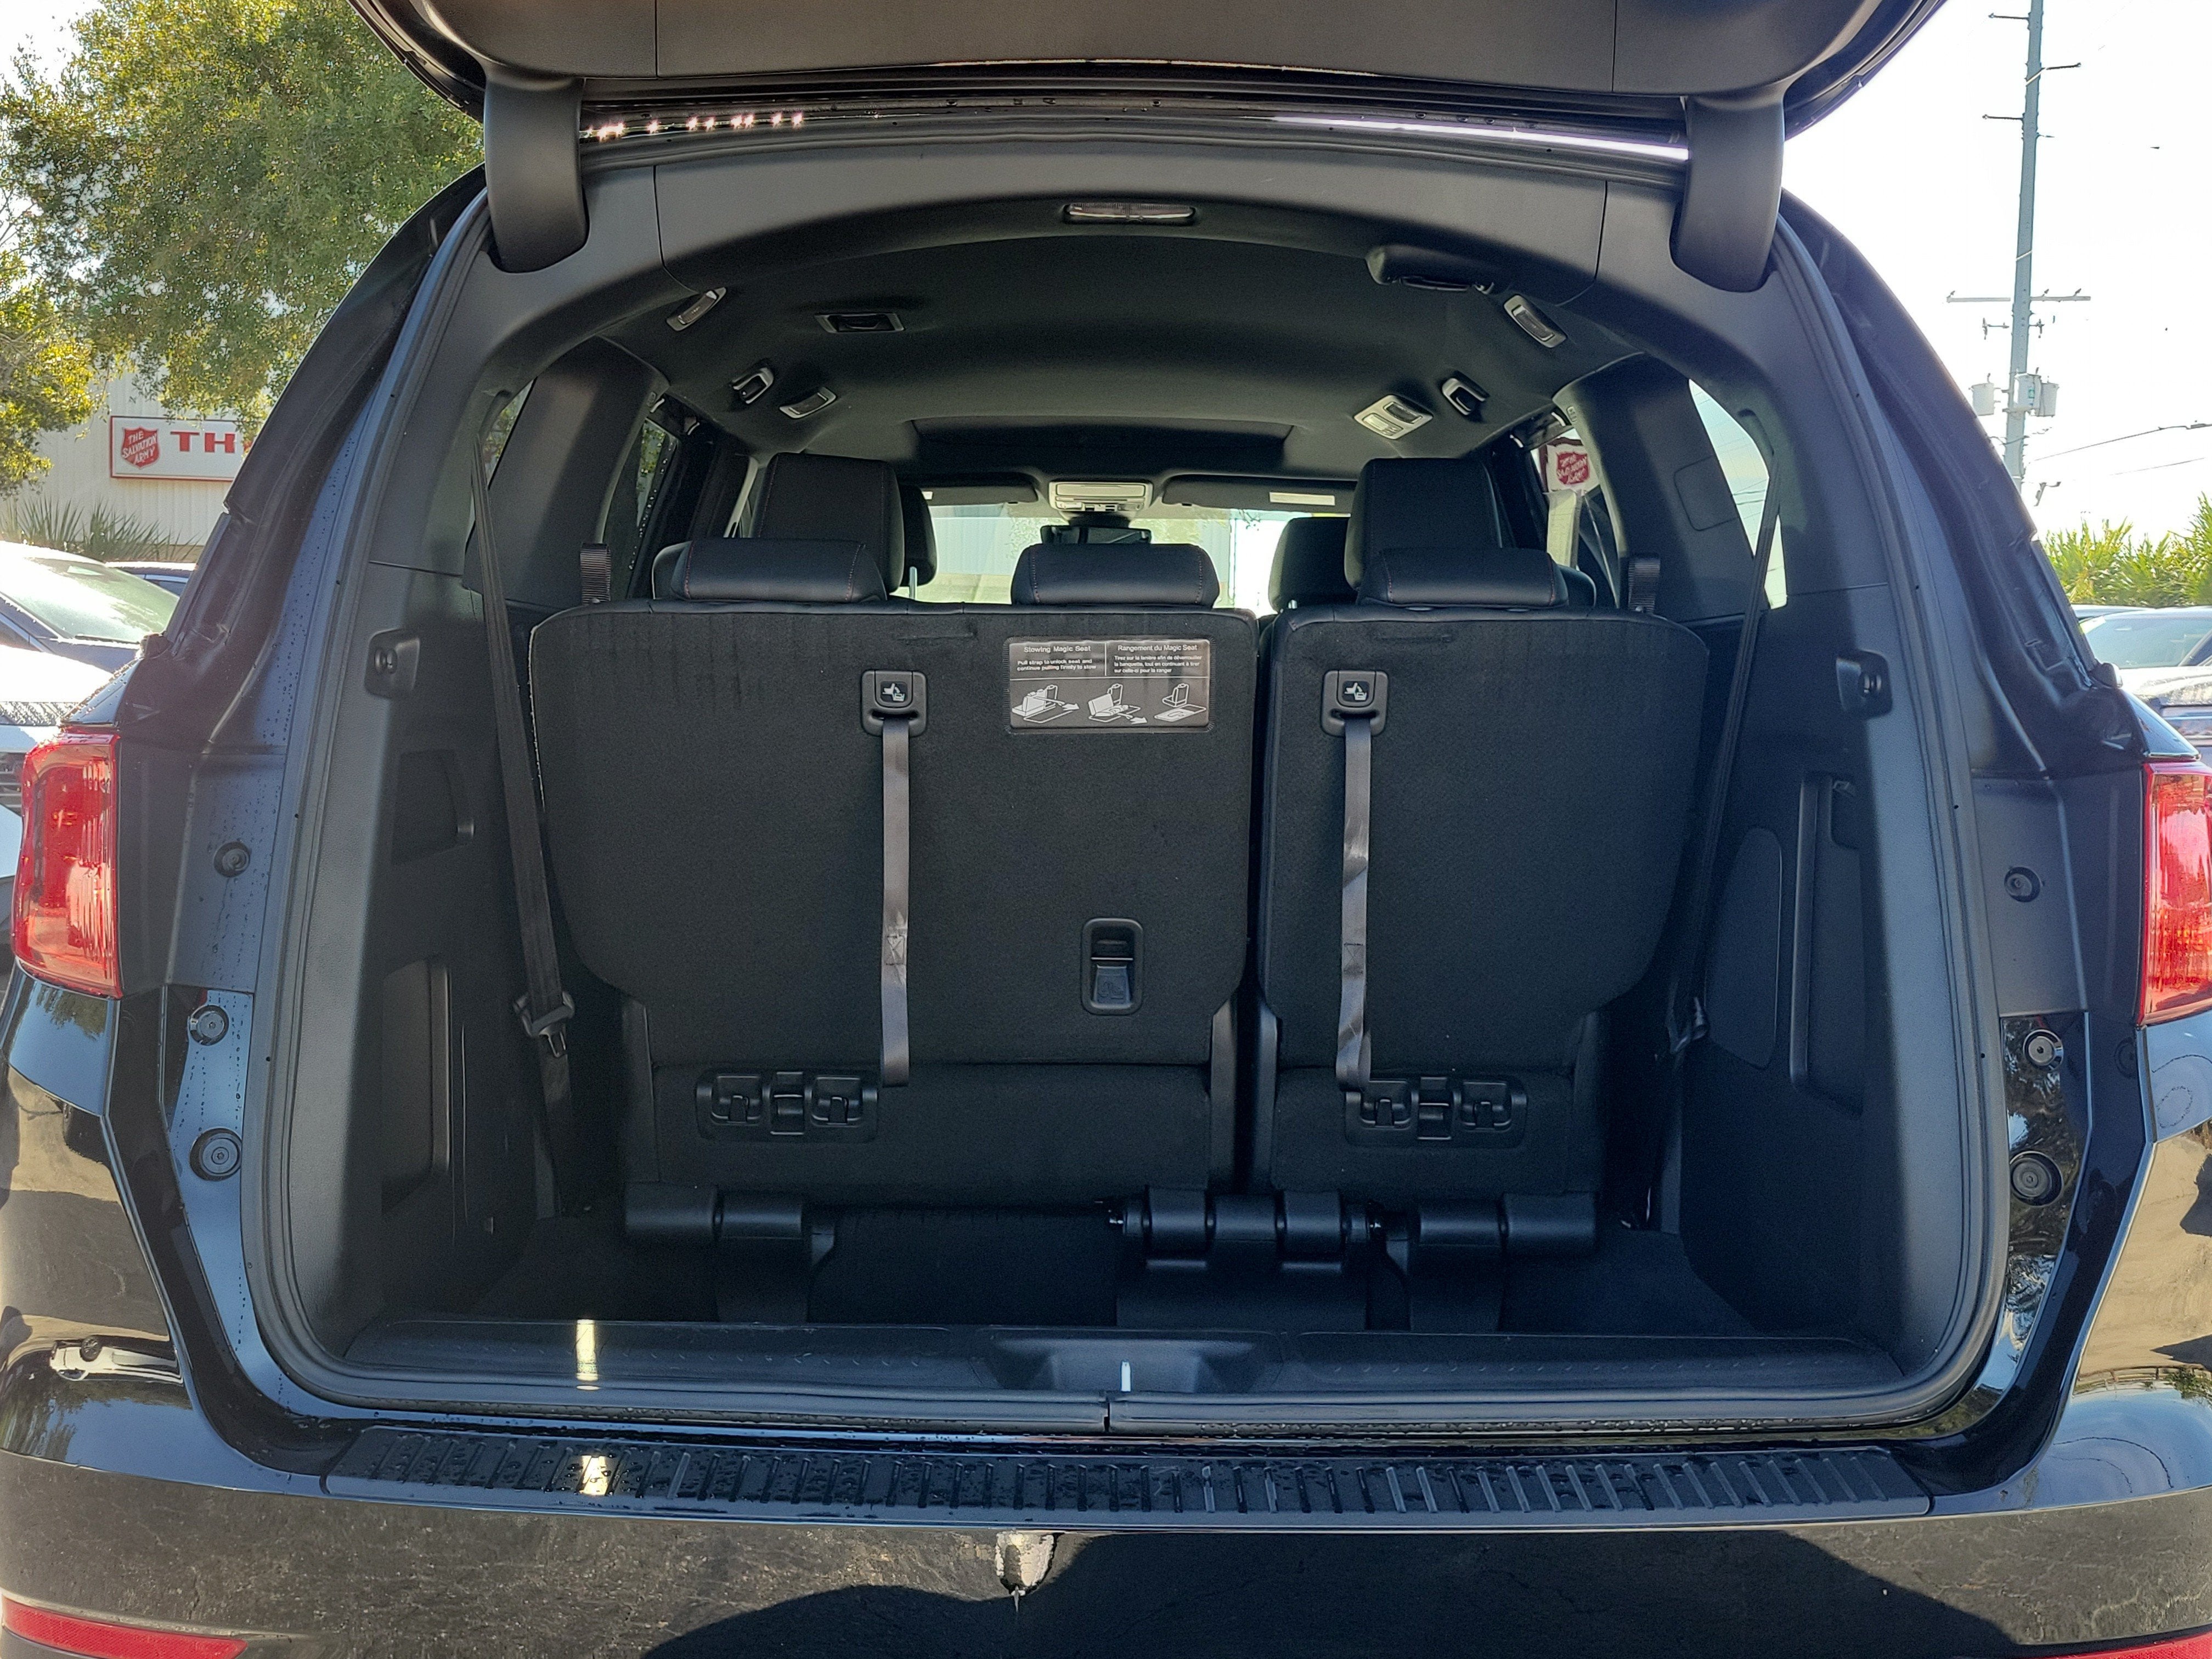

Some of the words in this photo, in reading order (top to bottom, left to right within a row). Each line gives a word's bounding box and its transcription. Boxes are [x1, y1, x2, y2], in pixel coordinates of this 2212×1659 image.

[122, 433, 157, 459] SALVATION
[128, 430, 144, 444] THE
[170, 431, 255, 453] TH
[134, 445, 156, 465] ARMY
